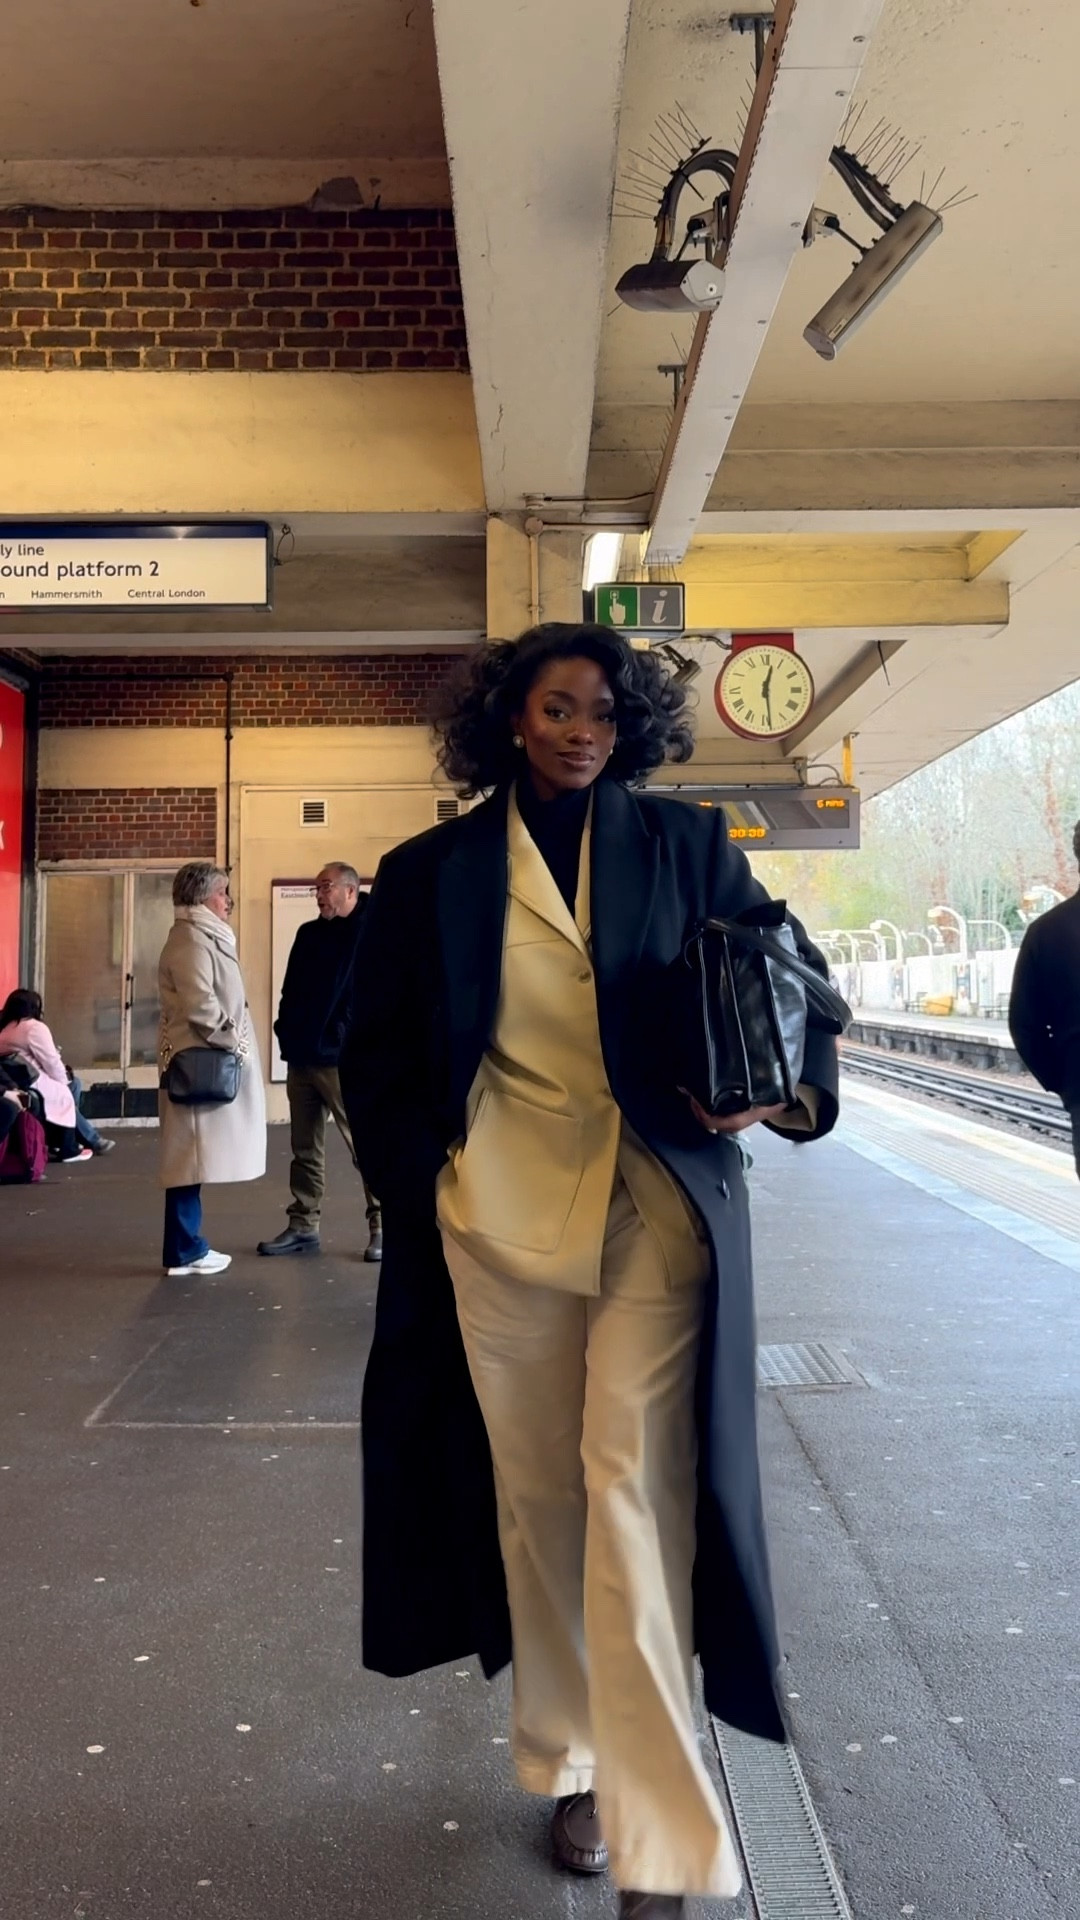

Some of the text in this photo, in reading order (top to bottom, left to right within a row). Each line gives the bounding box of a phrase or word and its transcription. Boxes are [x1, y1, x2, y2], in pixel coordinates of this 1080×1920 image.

[18, 543, 45, 556] line
[57, 560, 142, 581] platform
[149, 560, 160, 577] 2
[31, 589, 103, 599] Hammersmith
[127, 588, 165, 599] Central
[168, 588, 206, 598] London
